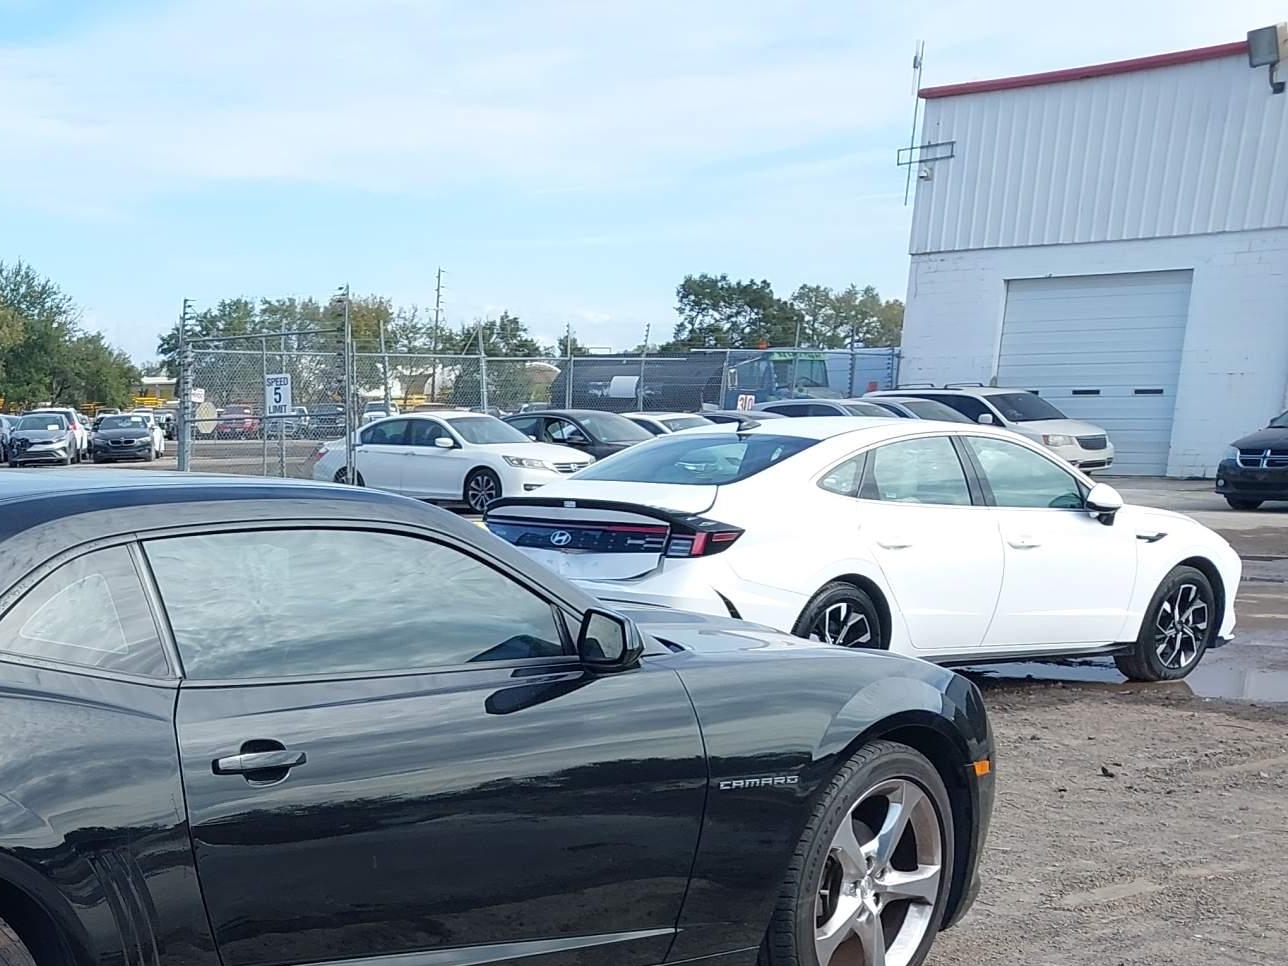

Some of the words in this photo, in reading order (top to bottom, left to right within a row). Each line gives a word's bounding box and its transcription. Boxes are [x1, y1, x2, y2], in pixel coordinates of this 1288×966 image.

[266, 376, 289, 387] SPEED
[274, 386, 282, 404] 5
[268, 404, 287, 415] LIMIT
[719, 775, 800, 790] CAMARO
